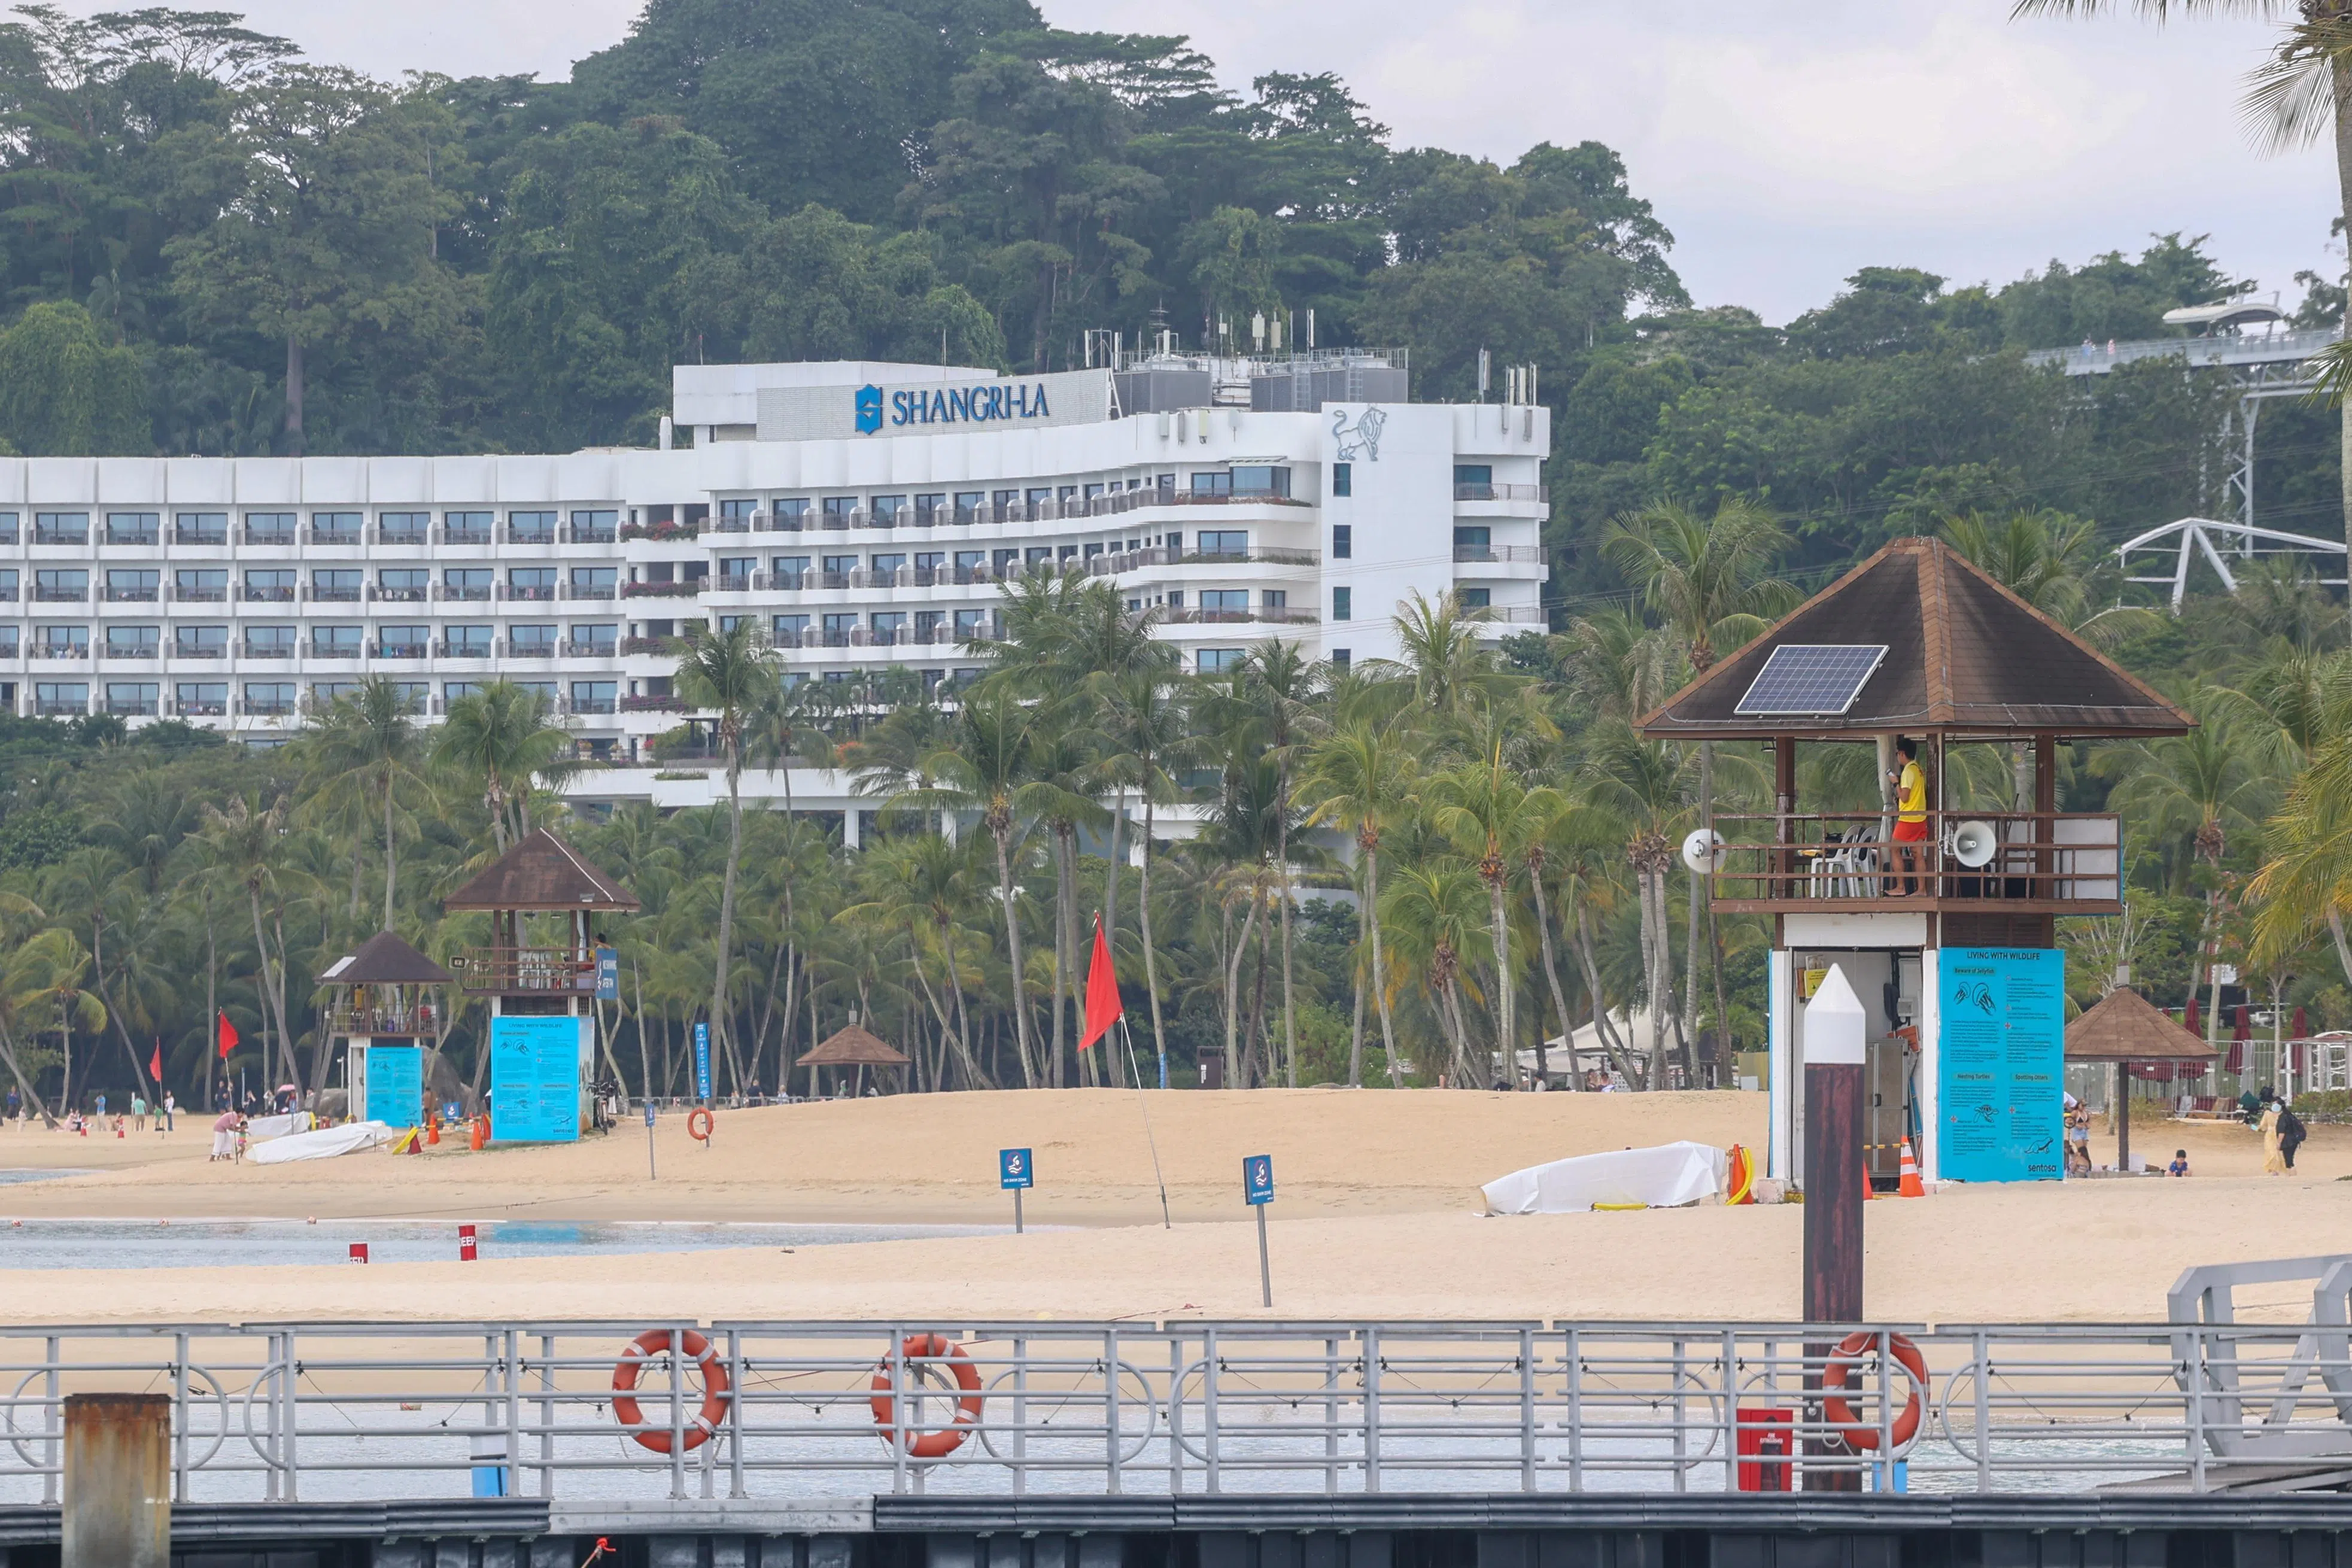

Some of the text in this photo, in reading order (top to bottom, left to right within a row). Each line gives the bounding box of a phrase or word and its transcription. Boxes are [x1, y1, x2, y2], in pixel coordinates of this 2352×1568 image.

[892, 383, 1049, 426] SHANGRI-LA
[1991, 952, 2008, 960] WITH
[2028, 1164, 2056, 1172] sentosa
